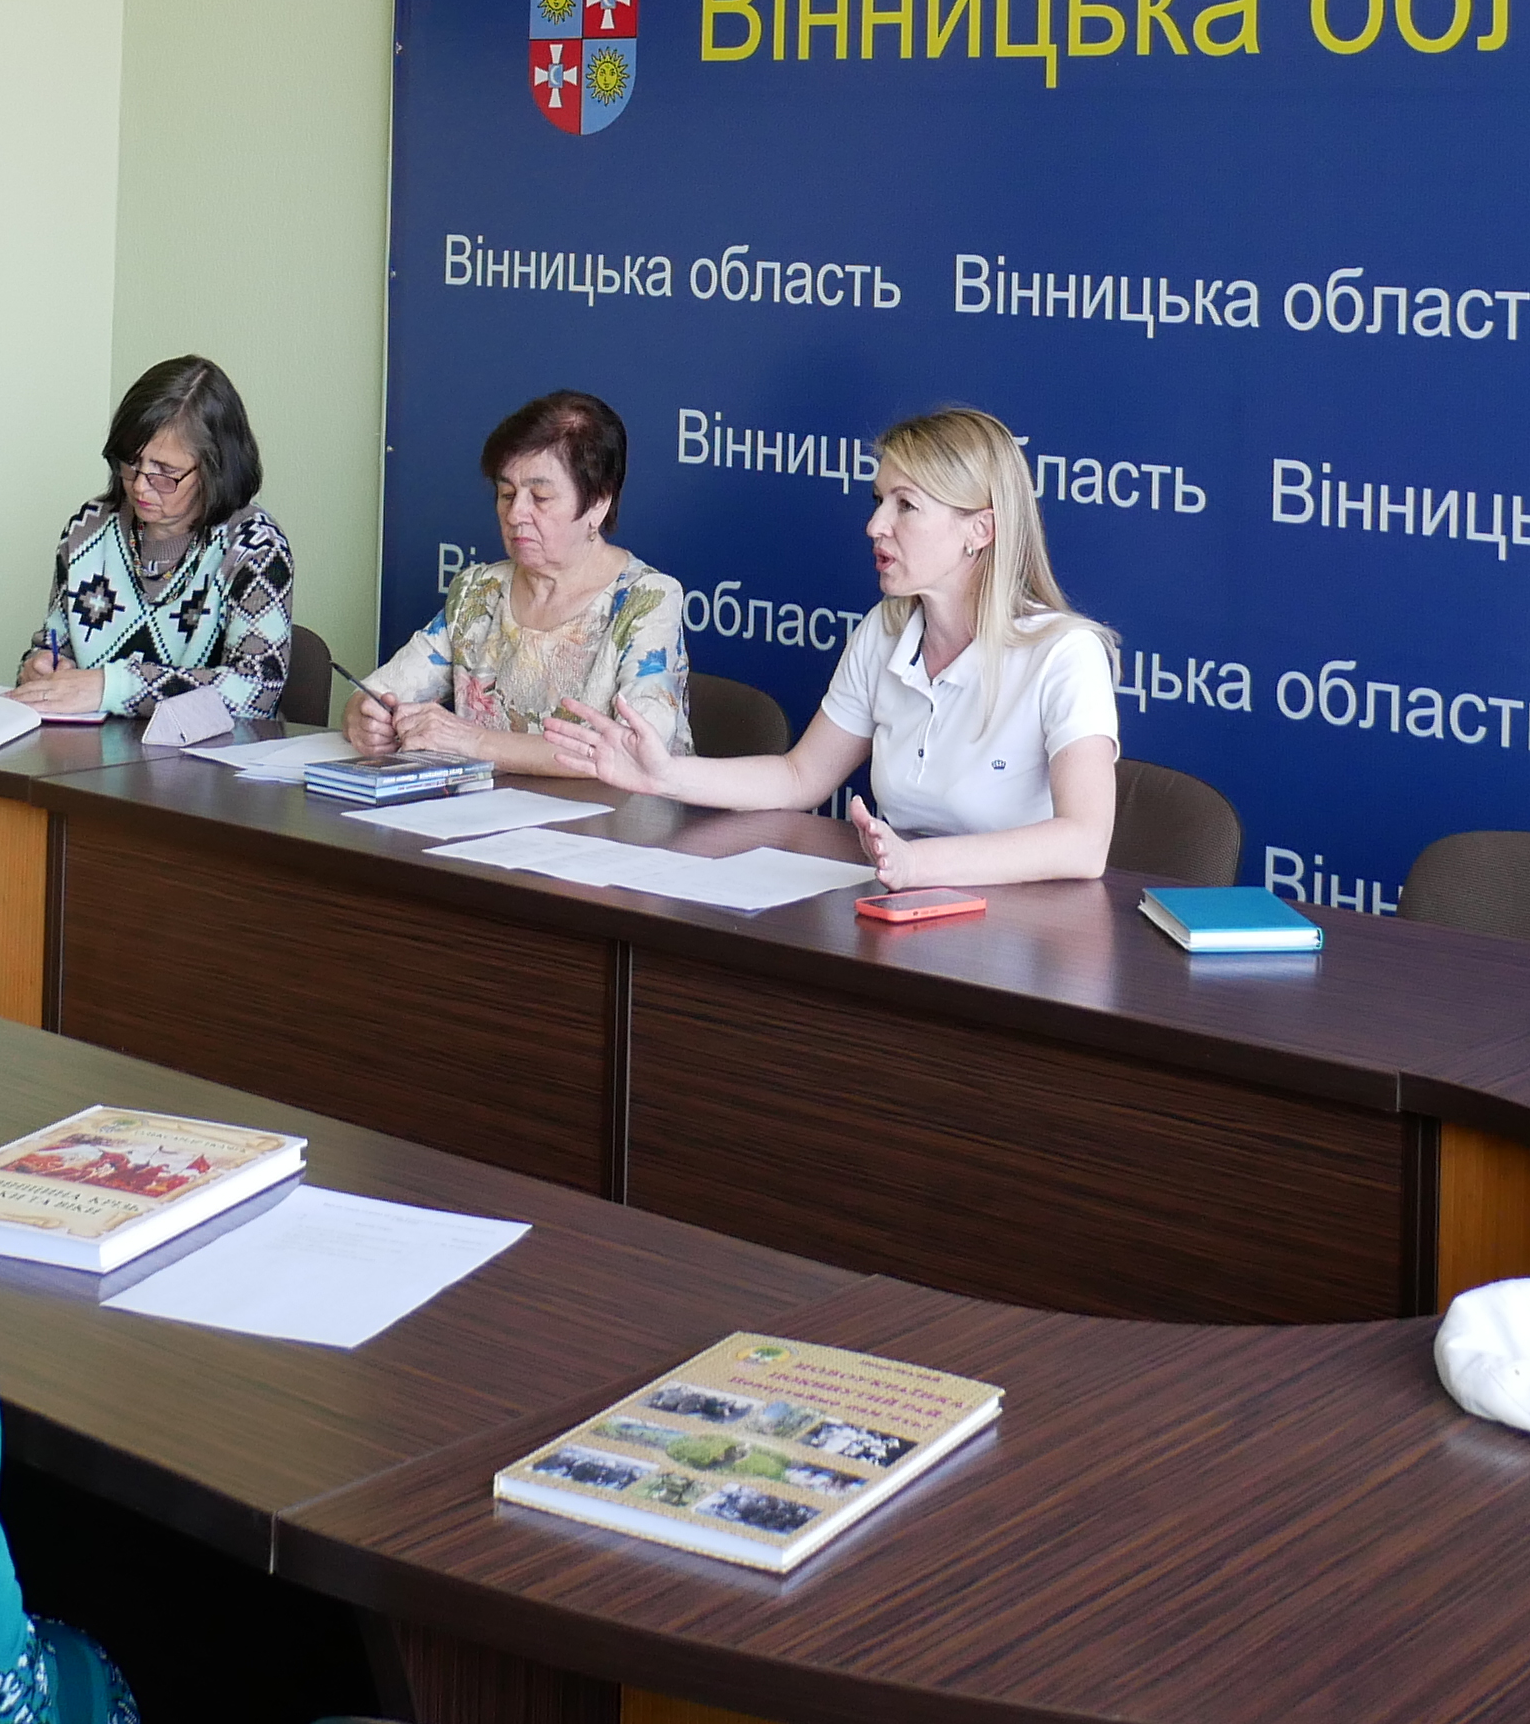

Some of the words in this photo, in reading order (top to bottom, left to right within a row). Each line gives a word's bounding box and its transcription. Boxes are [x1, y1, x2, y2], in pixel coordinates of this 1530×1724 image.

[444, 234, 673, 307] Вінницька
[689, 244, 901, 309] область
[955, 253, 1260, 339] Вінницька
[677, 407, 880, 495] Вінниць
[1012, 435, 1207, 514] ласть
[682, 580, 864, 652] област
